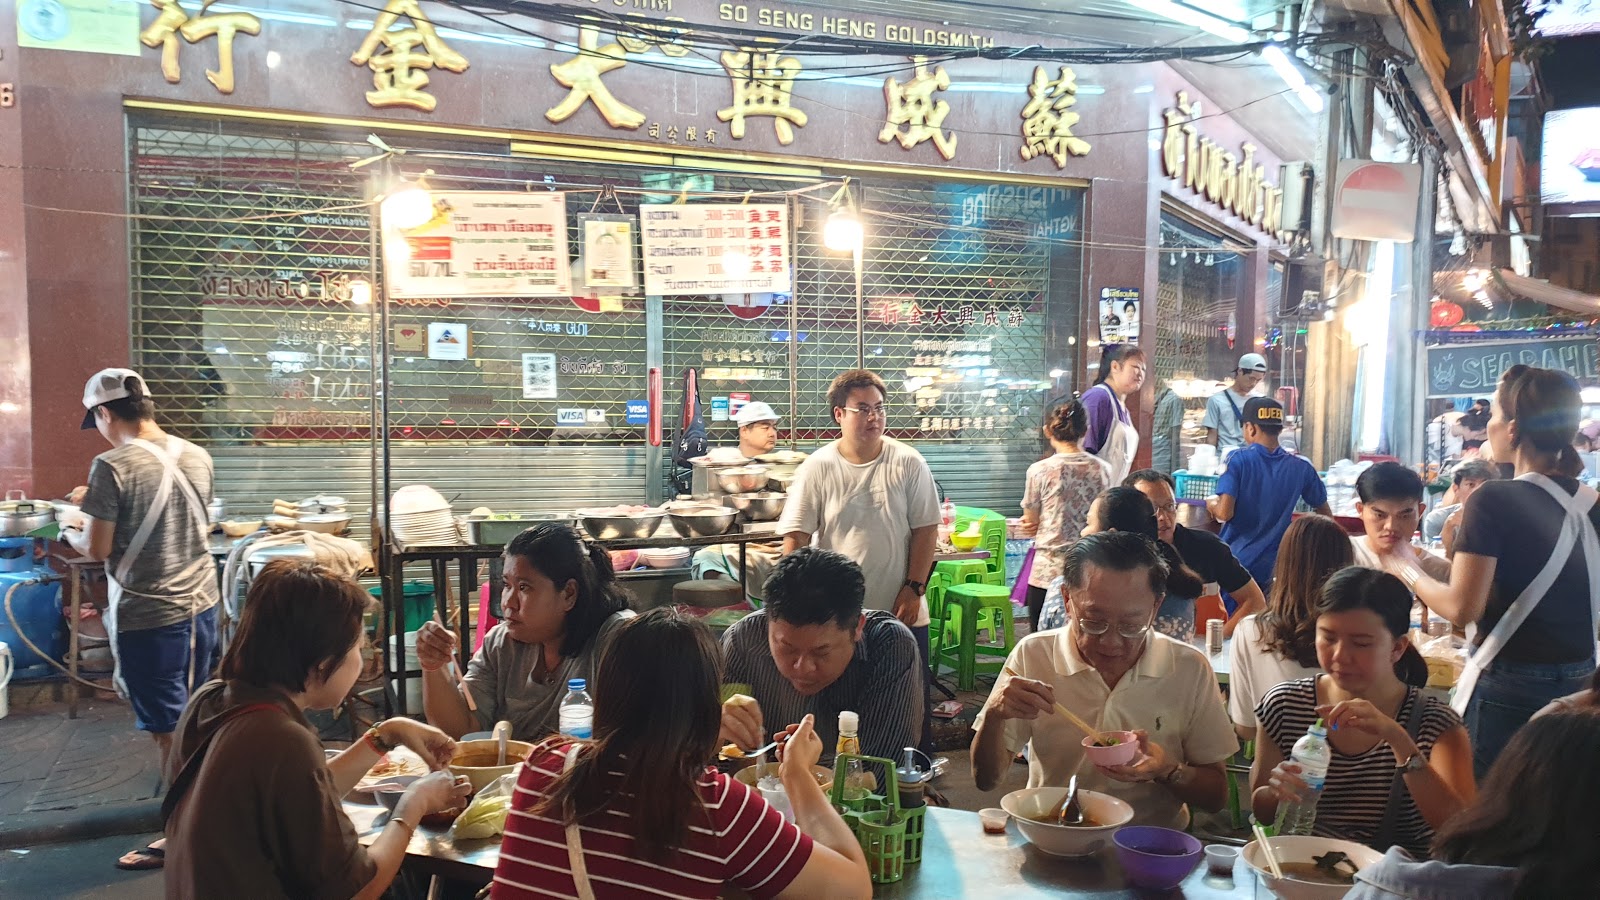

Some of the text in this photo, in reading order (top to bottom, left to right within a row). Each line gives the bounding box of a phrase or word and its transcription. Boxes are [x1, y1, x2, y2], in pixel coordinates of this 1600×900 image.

[719, 3, 995, 49] SO SENG HENG GOLDSMITH
[628, 405, 648, 413] VISA
[560, 411, 584, 421] VISA
